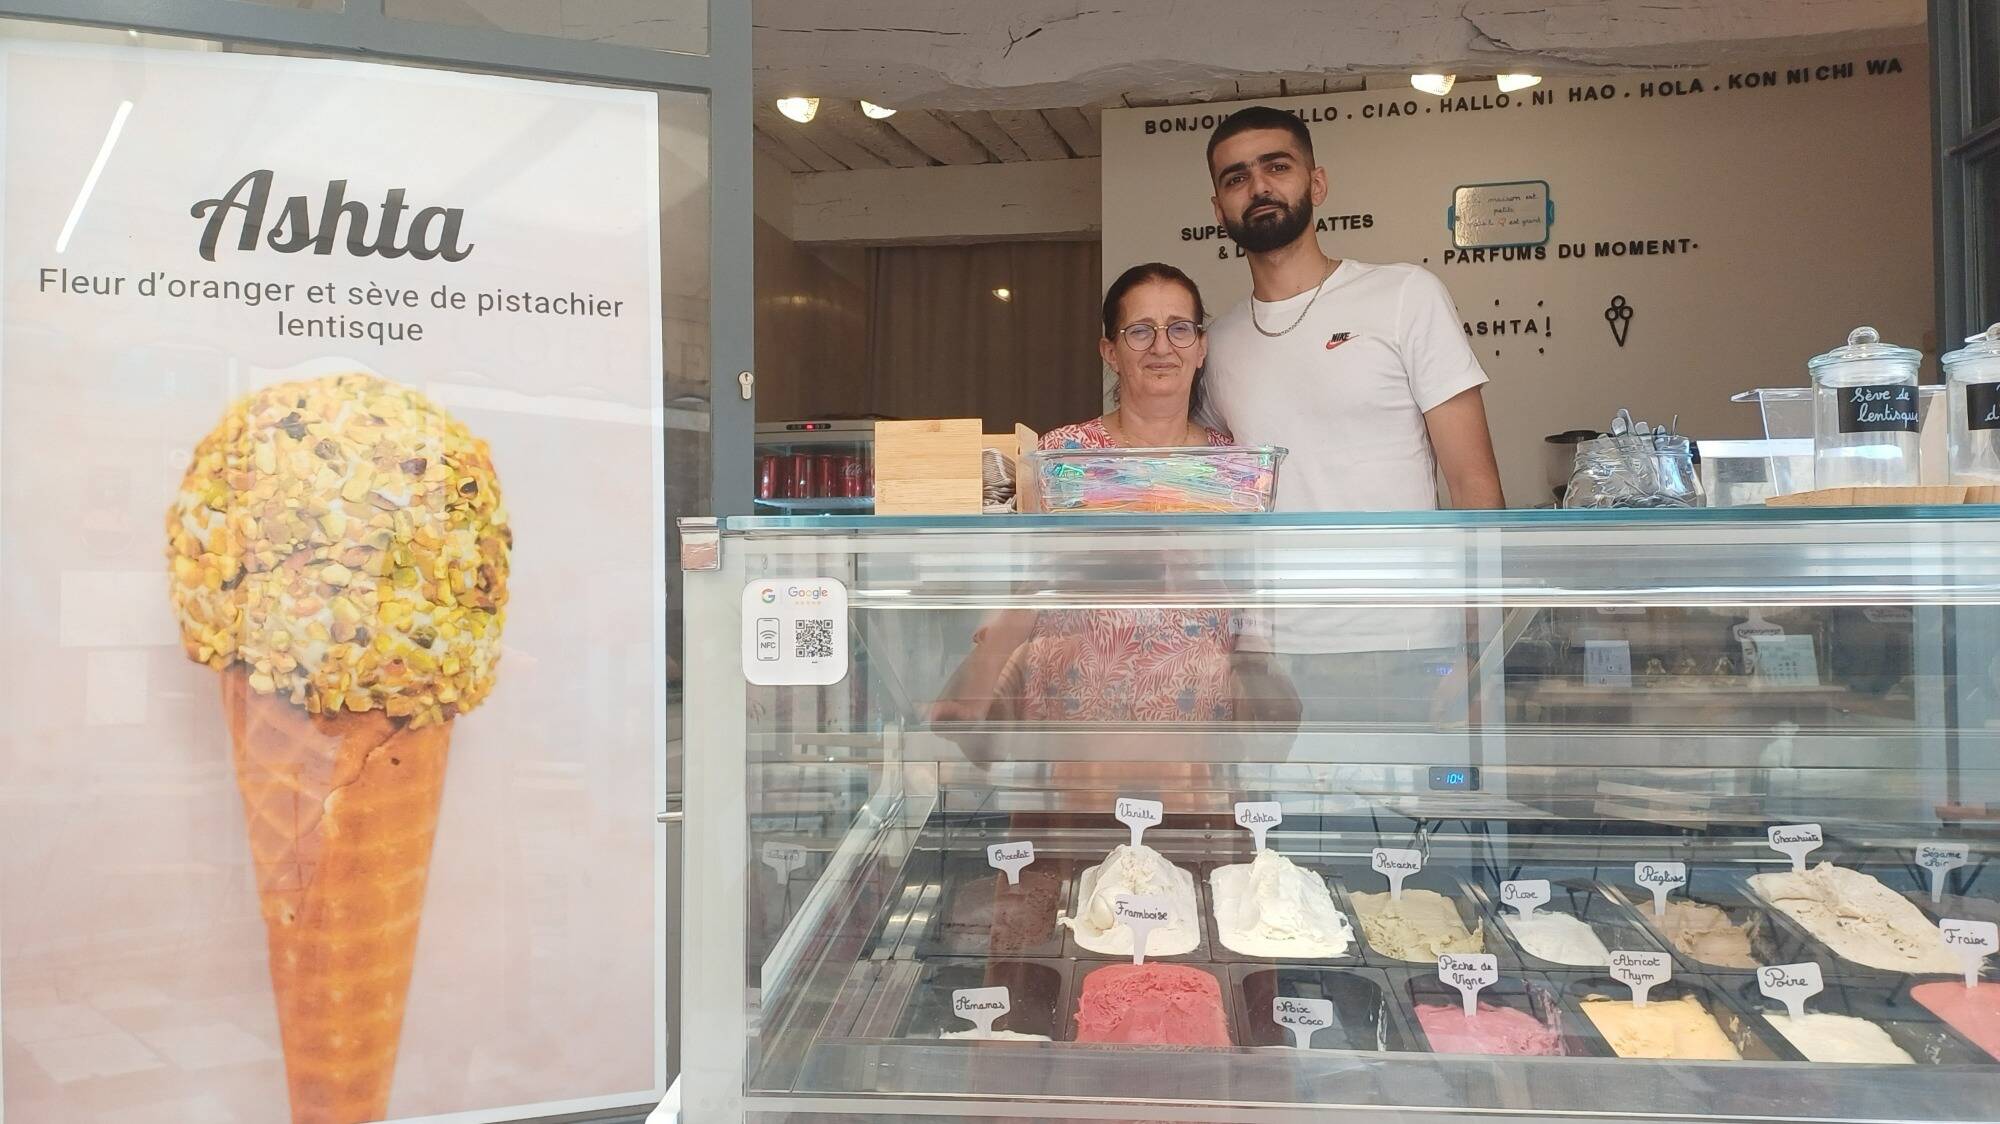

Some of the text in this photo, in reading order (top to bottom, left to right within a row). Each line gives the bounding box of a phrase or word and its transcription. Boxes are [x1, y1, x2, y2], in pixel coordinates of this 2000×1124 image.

[1362, 100, 1418, 119] CIAO
[1440, 93, 1511, 113] HALLO
[1532, 90, 1553, 106] NI
[1569, 84, 1616, 102] HAO
[1640, 78, 1704, 98] HOLA
[1728, 71, 1777, 89] KON
[1866, 58, 1903, 76] WA
[190, 169, 475, 262] Ashta
[1181, 224, 1228, 241] SUPE
[1444, 245, 1546, 265] PARFUMS
[1559, 243, 1586, 259] DU
[40, 267, 126, 297] Fleur
[307, 281, 336, 304] et
[349, 281, 419, 307] sève
[430, 285, 466, 310] de
[478, 288, 624, 318] pistachier
[278, 310, 424, 346] lentisque
[1331, 331, 1351, 343] NIKE
[1850, 387, 1910, 403] Sève de
[788, 586, 828, 600] Google
[760, 641, 776, 649] NFC
[1119, 802, 1156, 820] Vanille
[1240, 809, 1277, 823] Ashta
[994, 849, 1030, 862] Chocolat
[1115, 900, 1168, 920] Framboise
[1944, 928, 1988, 946] Fraise
[1480, 962, 1494, 971] de
[1613, 954, 1661, 967] Abricot
[1452, 972, 1486, 990] Vigne
[1618, 968, 1655, 986] Thym
[1764, 967, 1809, 988] Poire
[1299, 1015, 1324, 1026] Coco
